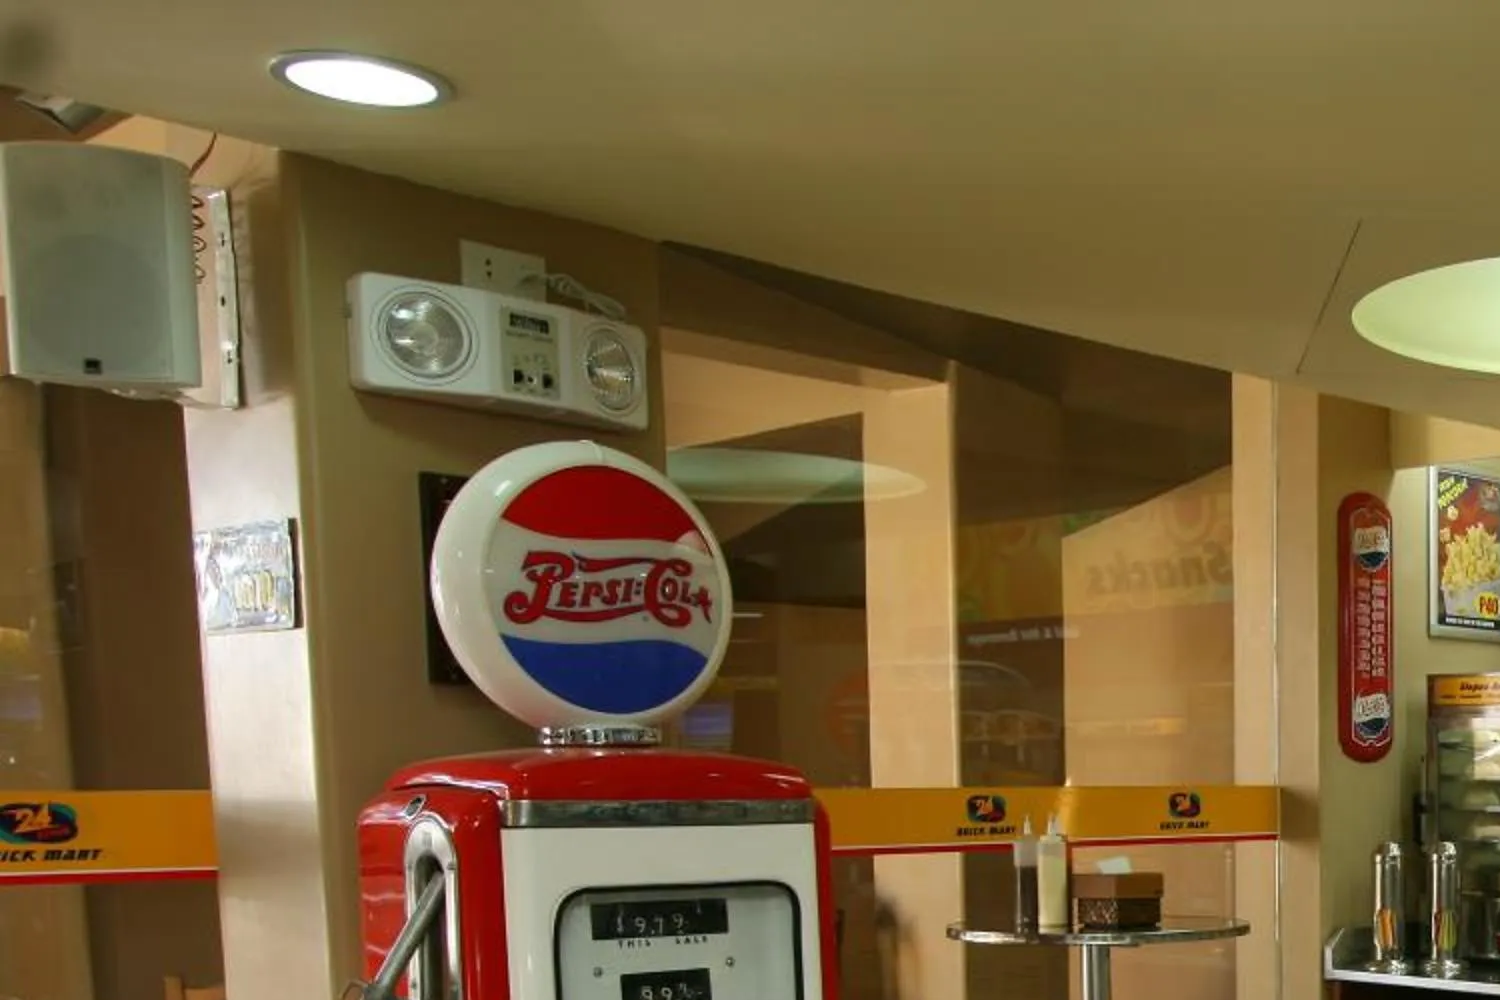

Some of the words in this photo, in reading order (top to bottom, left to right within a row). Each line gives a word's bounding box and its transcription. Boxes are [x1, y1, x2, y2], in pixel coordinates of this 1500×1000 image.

[44, 849, 103, 862] MART
[618, 936, 652, 949] THIS
[675, 934, 709, 946] SALE
